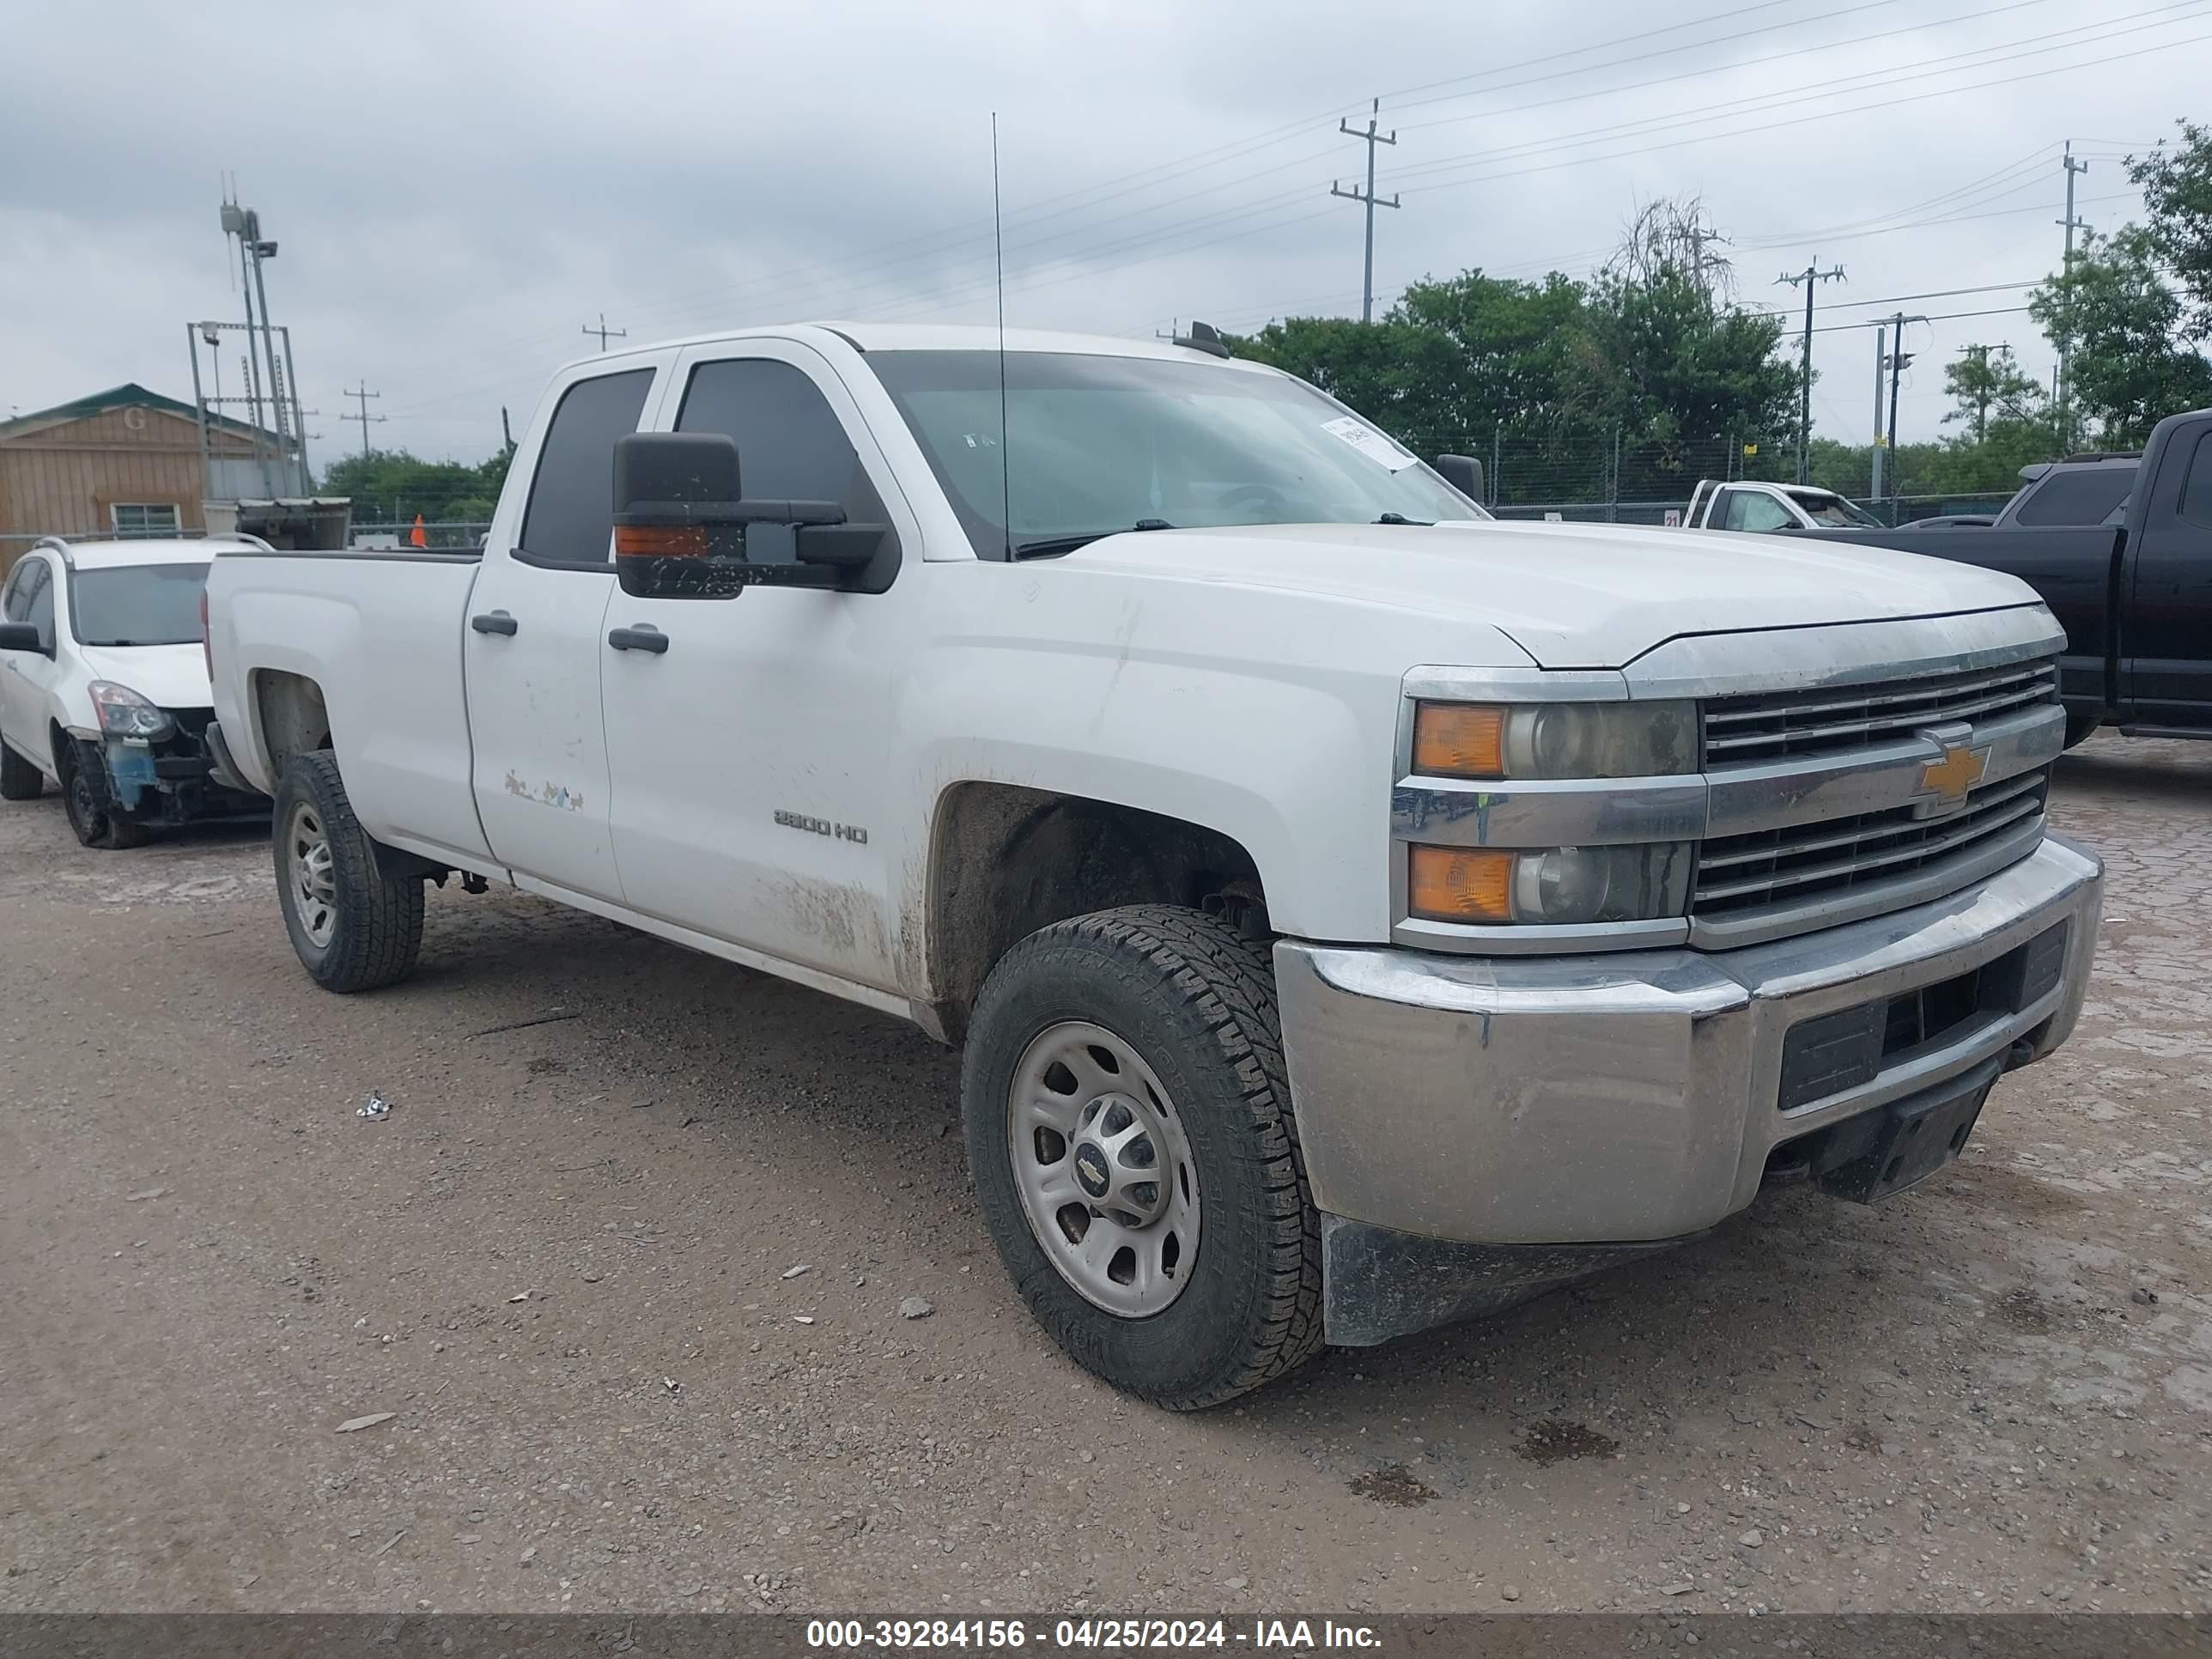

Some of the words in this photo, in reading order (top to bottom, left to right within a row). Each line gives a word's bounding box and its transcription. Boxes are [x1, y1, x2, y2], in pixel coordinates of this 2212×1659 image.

[124, 407, 145, 429] G
[1666, 515, 1677, 526] 21
[835, 823, 867, 845] HD
